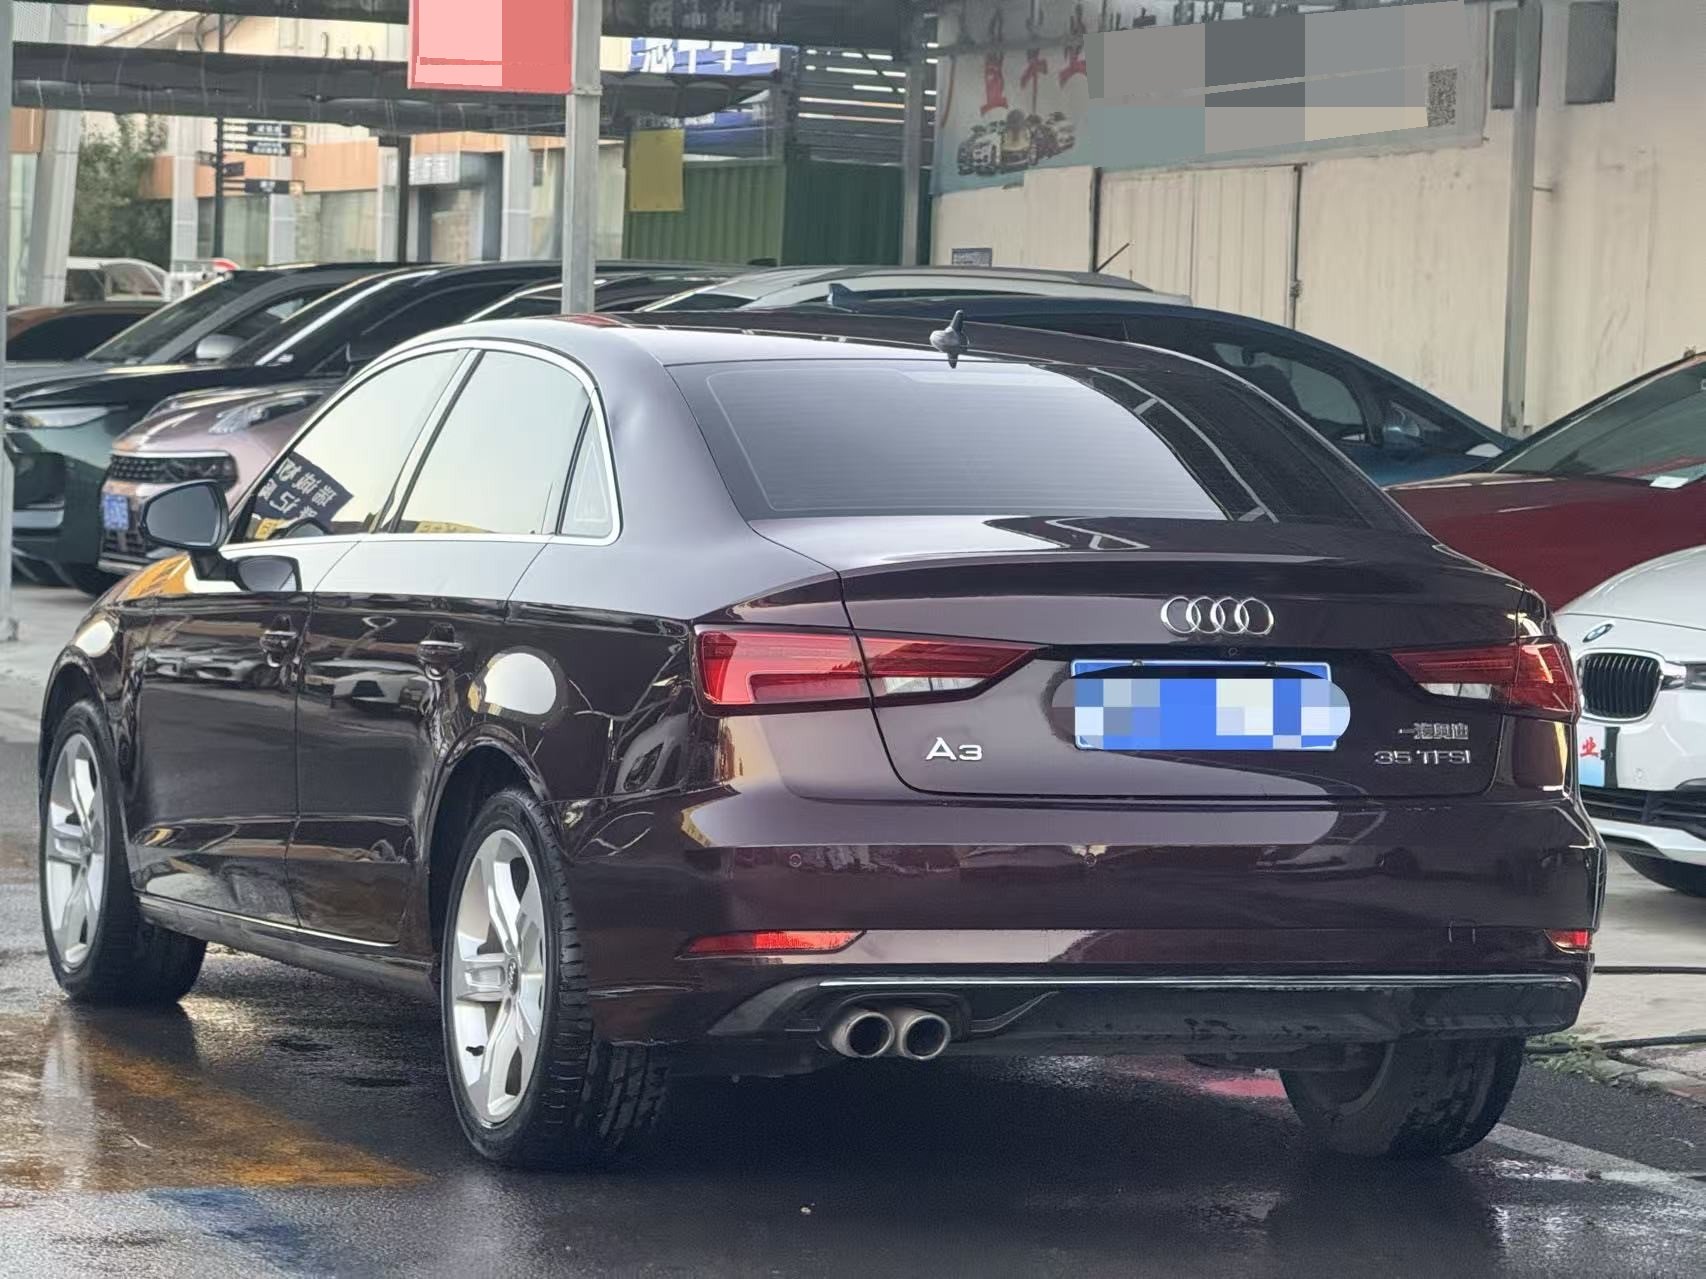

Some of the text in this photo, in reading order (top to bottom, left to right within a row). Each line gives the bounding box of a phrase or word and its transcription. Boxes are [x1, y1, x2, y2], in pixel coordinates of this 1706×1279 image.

[1398, 722, 1469, 740] 一汽奥迪
[925, 736, 983, 761] A3
[1373, 749, 1472, 764] 35 TFSI
